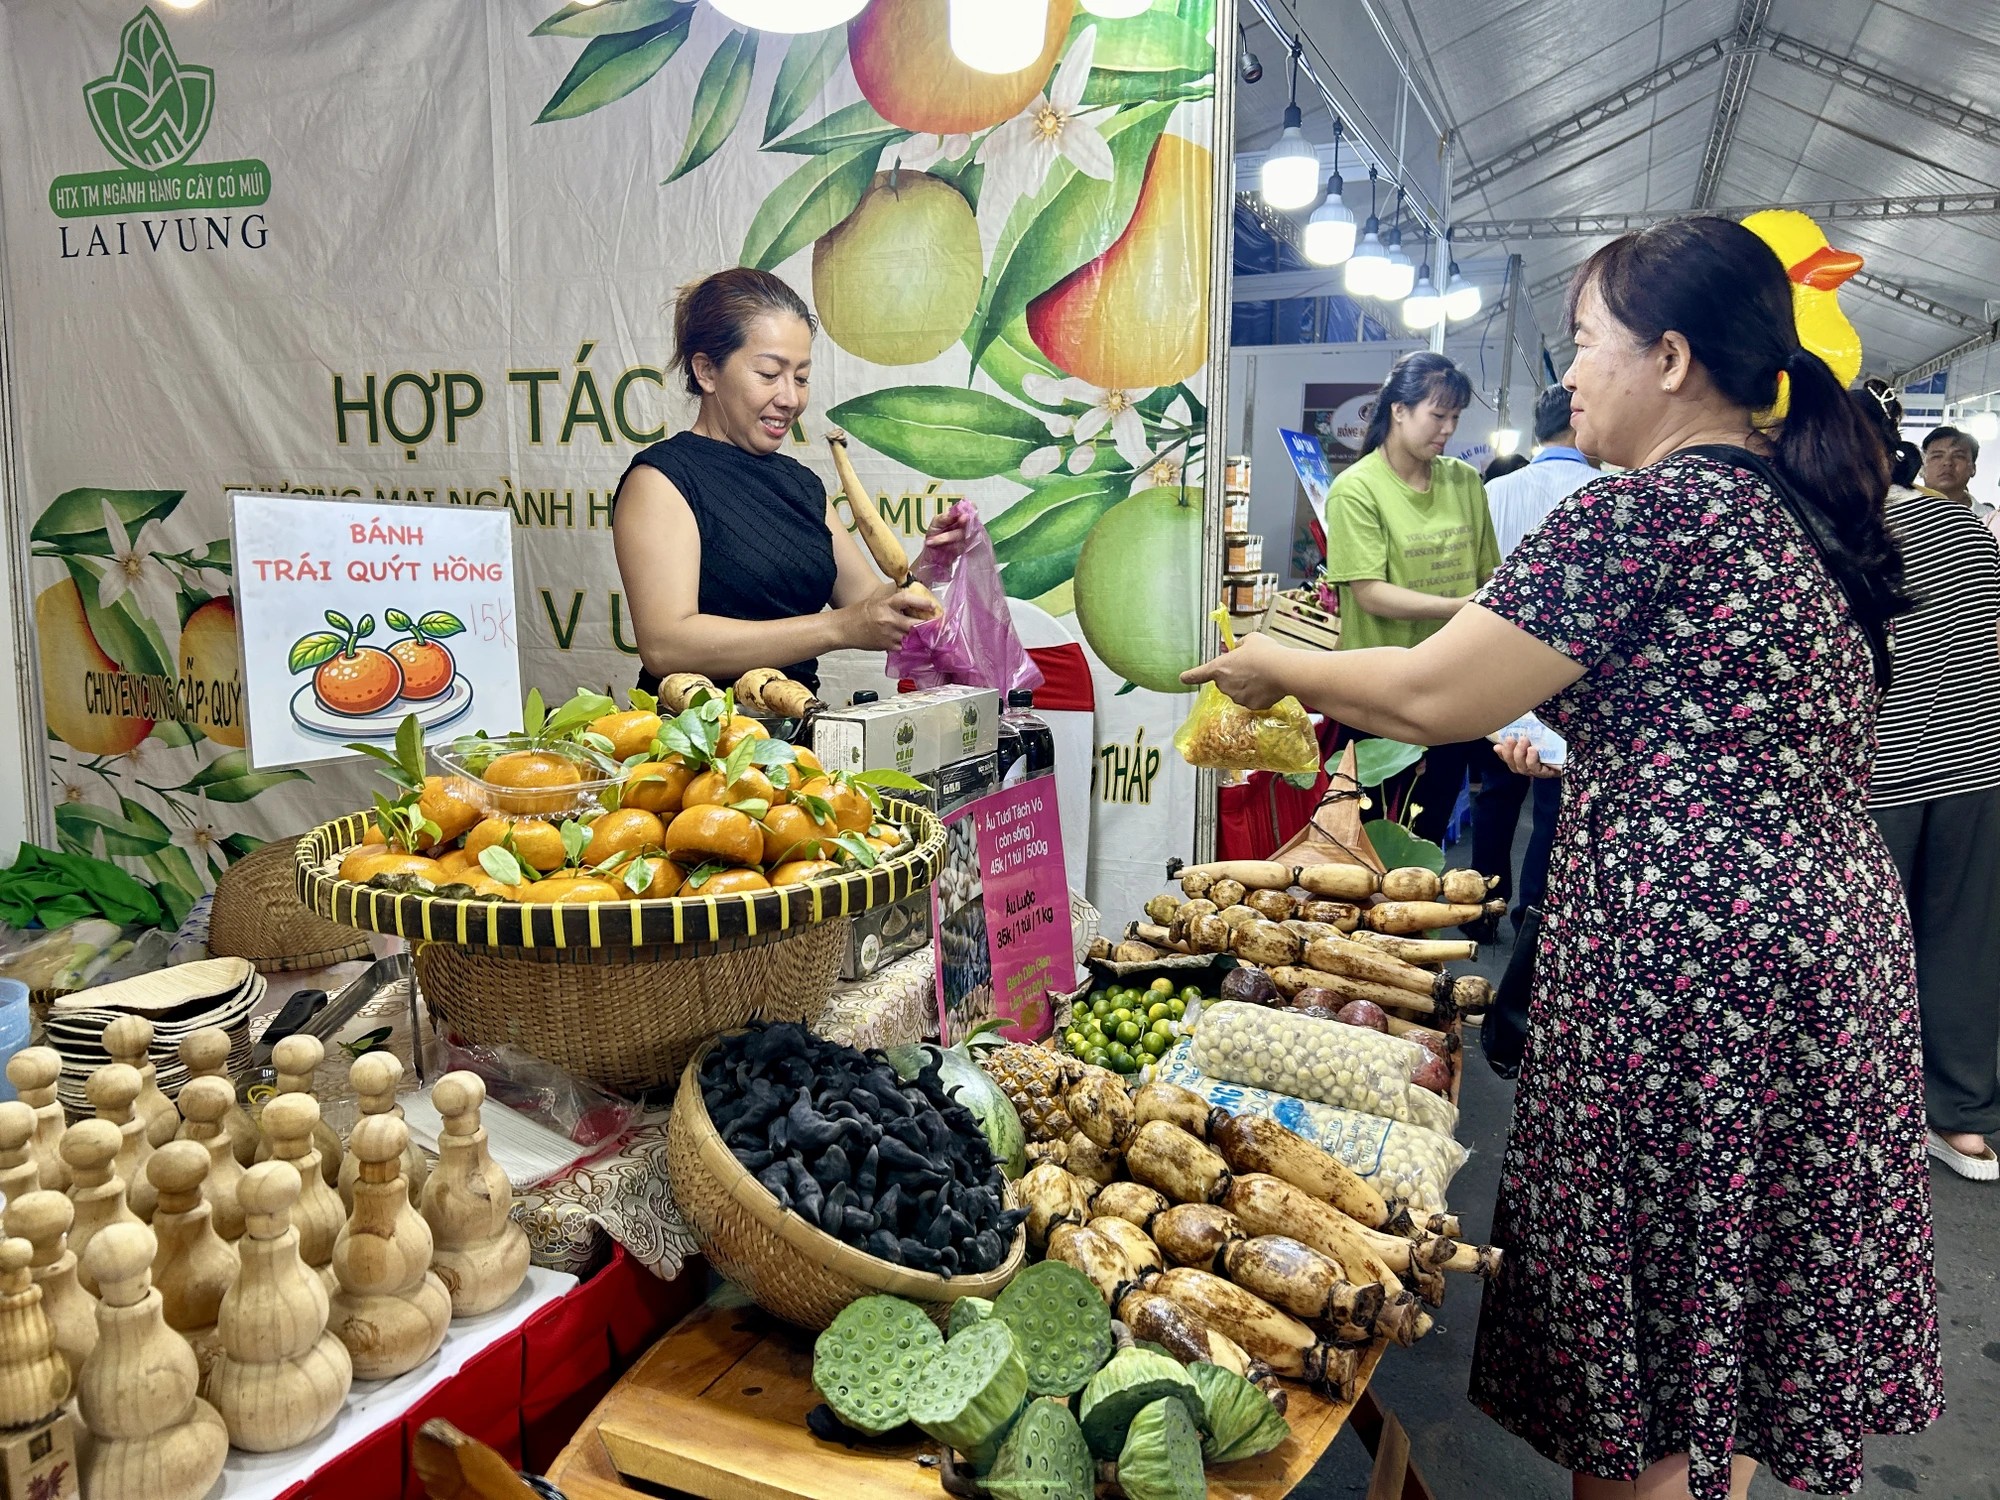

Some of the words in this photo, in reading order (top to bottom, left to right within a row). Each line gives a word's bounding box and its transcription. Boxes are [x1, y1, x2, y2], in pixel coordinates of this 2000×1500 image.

[56, 186, 79, 210] HTX
[81, 184, 100, 208] TM
[103, 176, 145, 205] NGÀNH
[149, 173, 181, 202] HÀNG
[185, 173, 213, 199] CÂY
[217, 168, 235, 198] CÓ
[239, 166, 264, 197] MÚI
[58, 221, 130, 258] LAI
[141, 214, 269, 253] VUNG
[332, 371, 485, 462] HỢP
[507, 340, 668, 447] TÁC
[350, 517, 424, 546] BÁNH
[252, 552, 332, 582] TRÁI
[347, 554, 422, 583] QUÝT
[433, 555, 502, 582] HỒNG
[140, 674, 177, 722] CUNG
[1100, 727, 1161, 804] THÁP
[1012, 801, 1031, 820] Tách
[1031, 797, 1043, 813] Vỏ
[1016, 889, 1036, 913] Luộc
